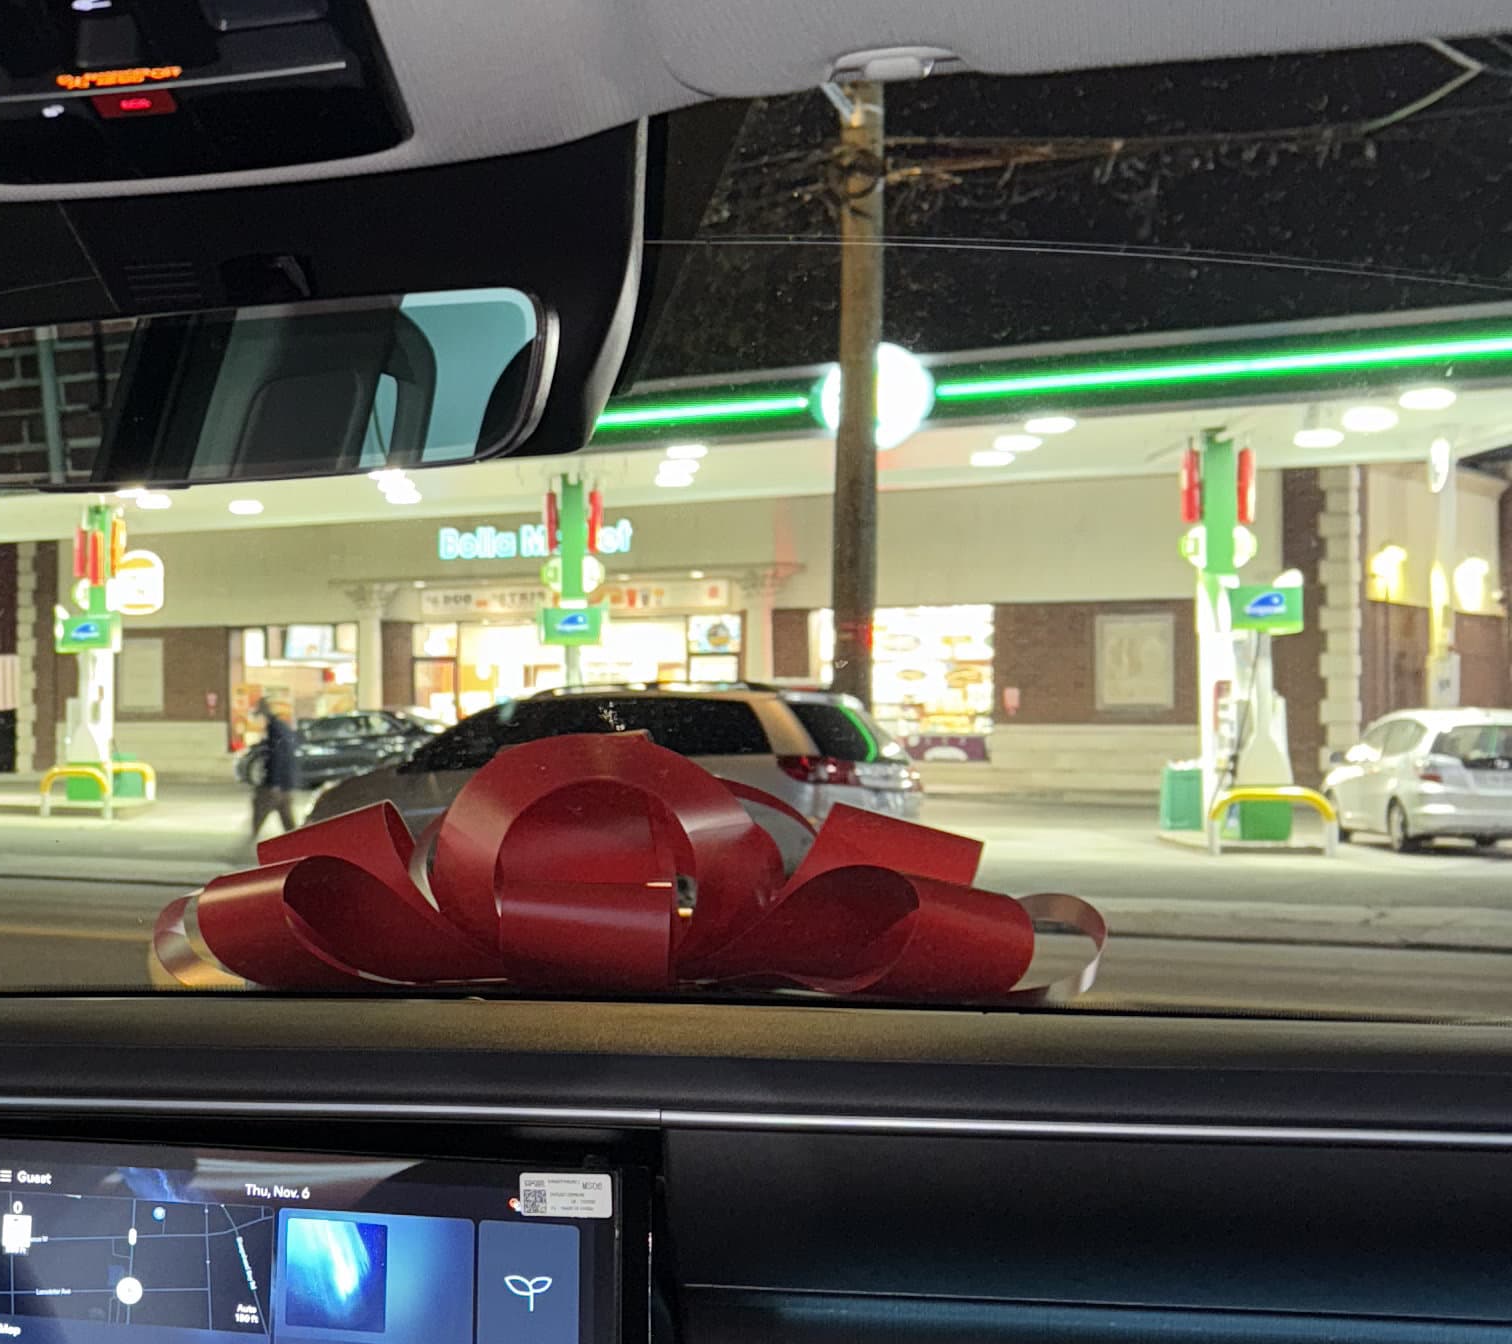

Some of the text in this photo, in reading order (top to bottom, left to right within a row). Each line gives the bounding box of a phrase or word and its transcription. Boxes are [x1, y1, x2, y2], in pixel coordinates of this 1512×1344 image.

[17, 1170, 52, 1185] Guest
[245, 1184, 311, 1200] Thu, Nov. 6
